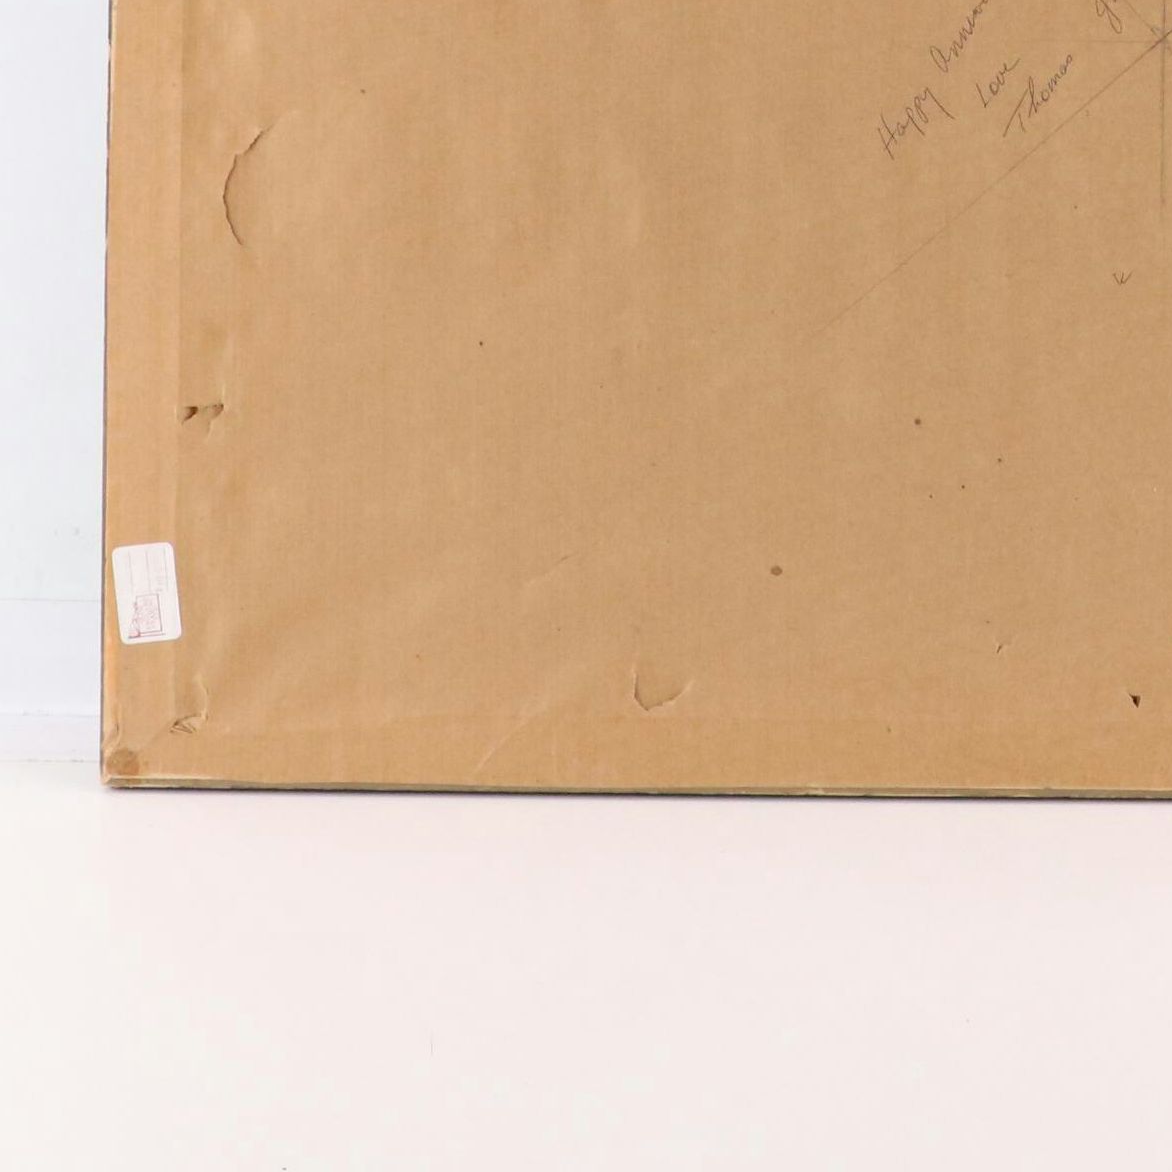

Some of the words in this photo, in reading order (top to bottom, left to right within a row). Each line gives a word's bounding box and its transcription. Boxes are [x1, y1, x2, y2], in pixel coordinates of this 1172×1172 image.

[976, 58, 1021, 109] Love
[1003, 54, 1073, 138] Thomas
[877, 87, 954, 161] Happy
